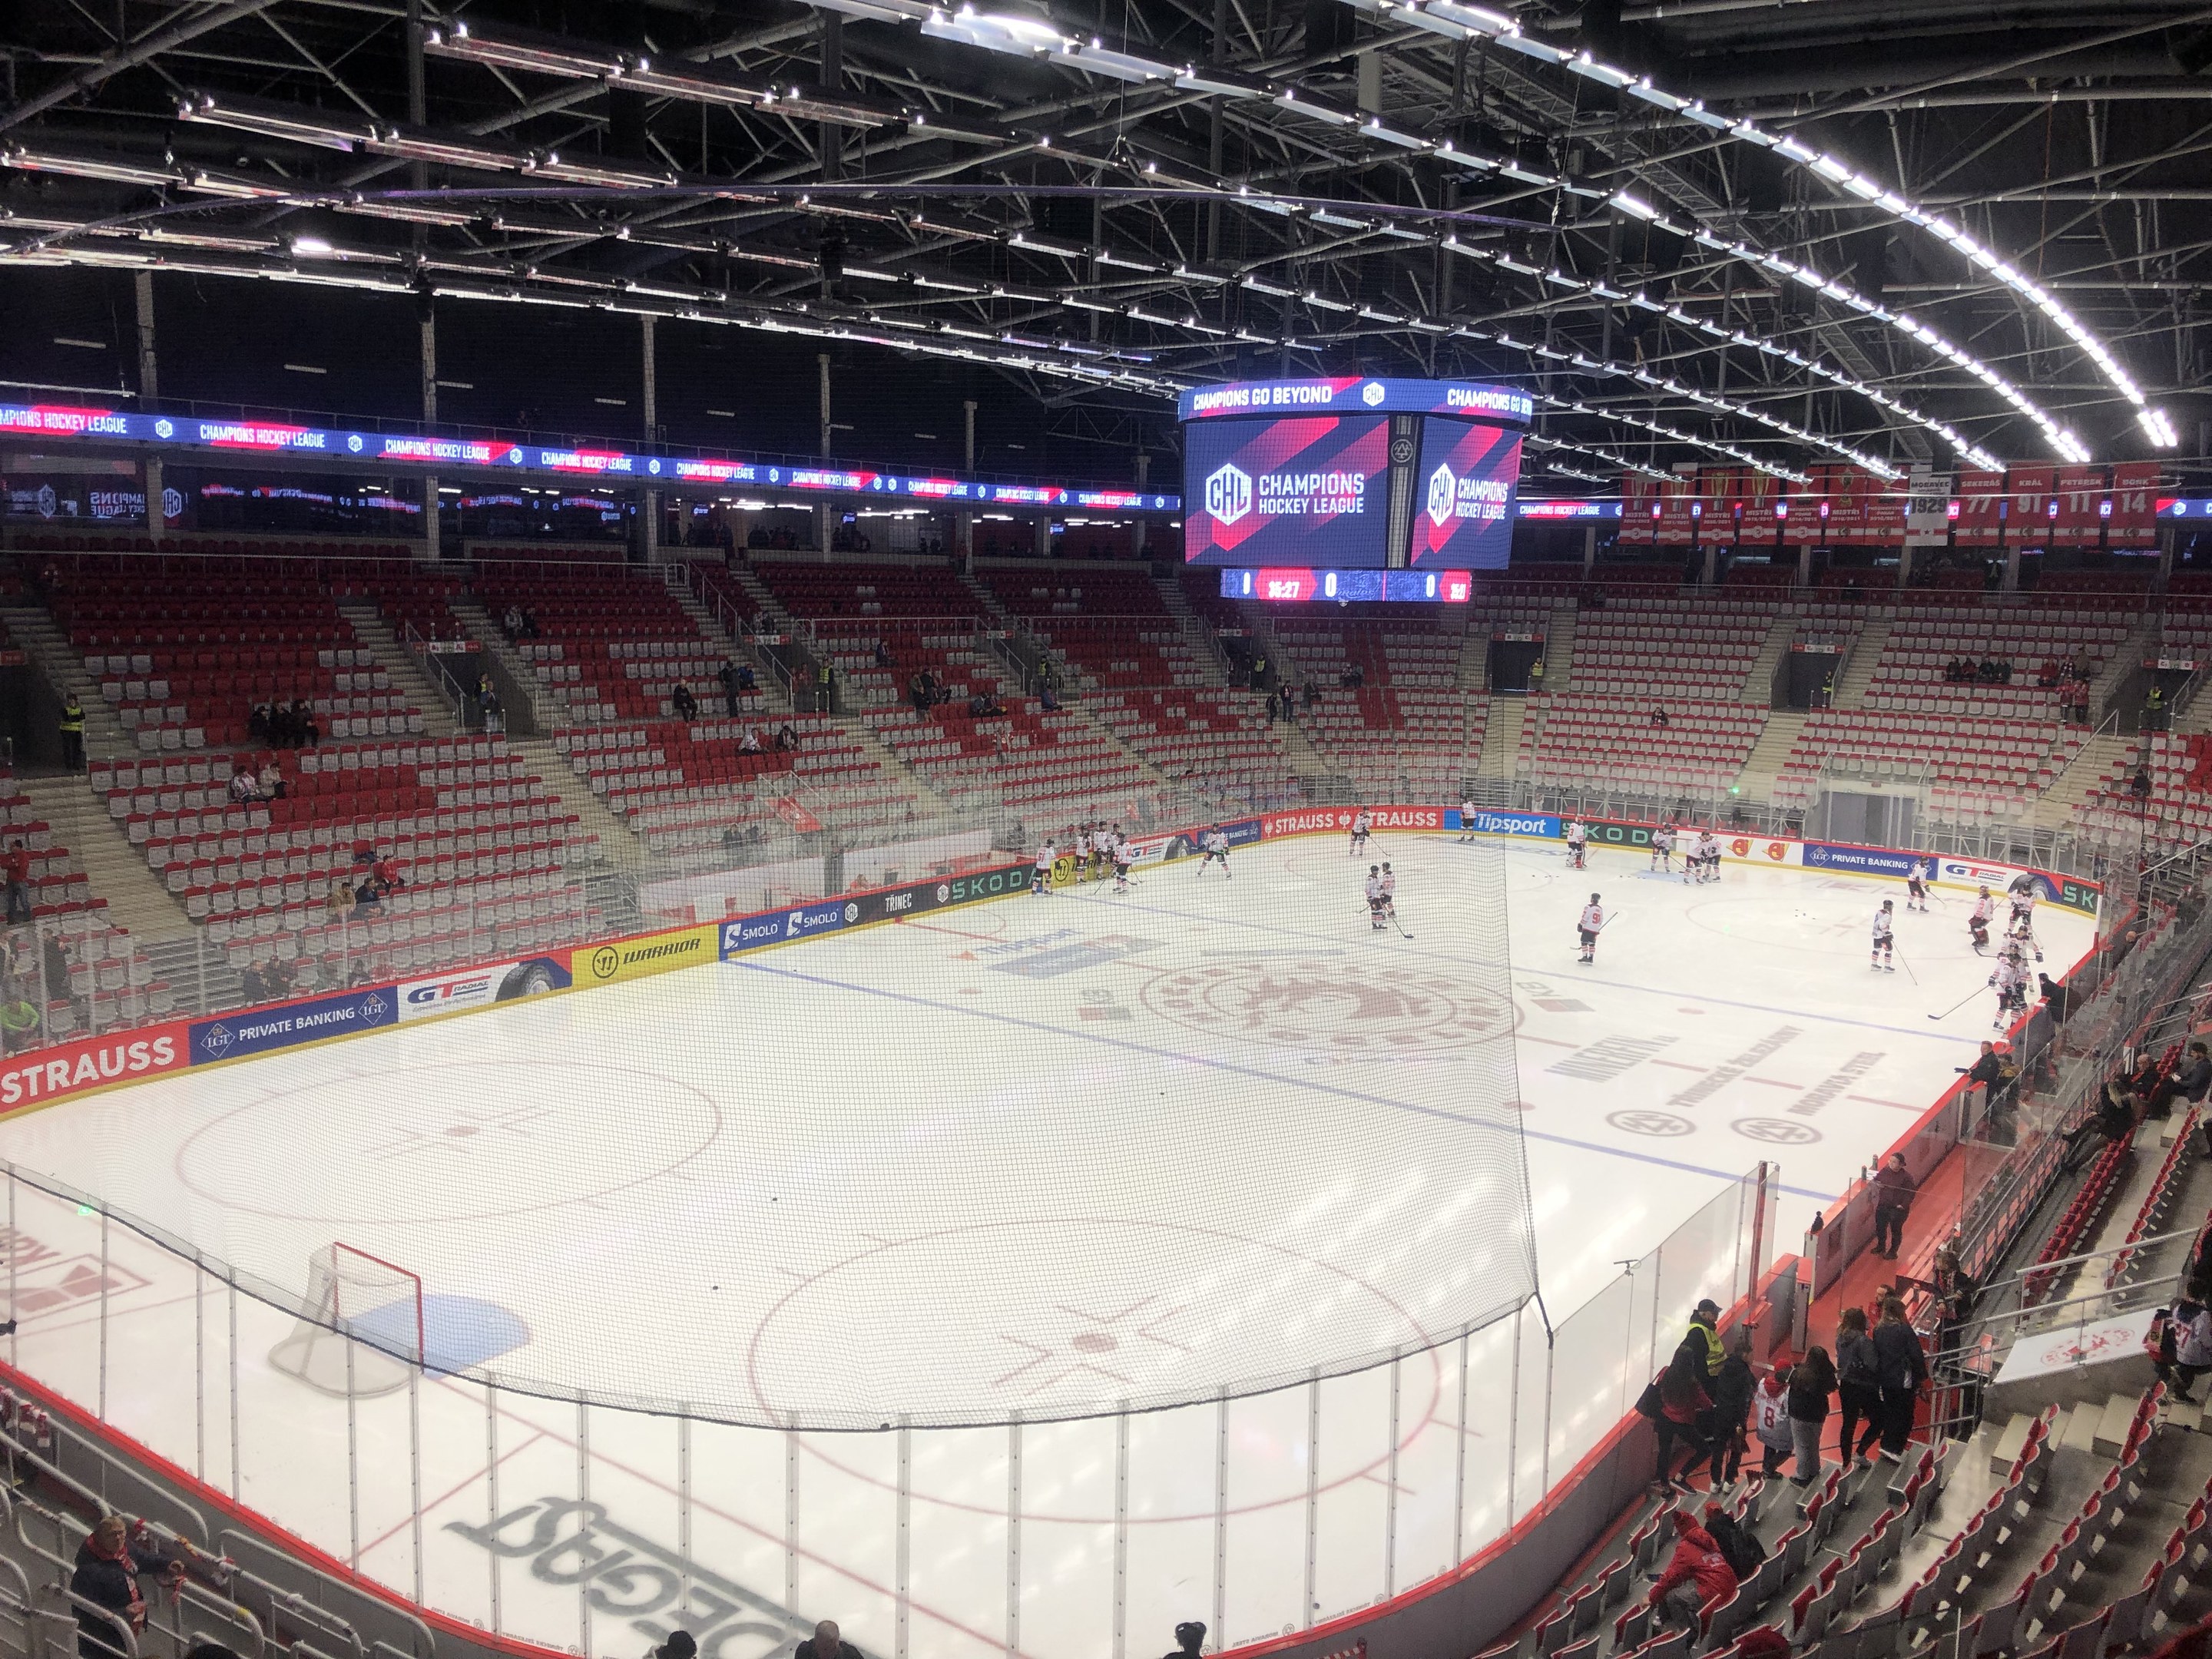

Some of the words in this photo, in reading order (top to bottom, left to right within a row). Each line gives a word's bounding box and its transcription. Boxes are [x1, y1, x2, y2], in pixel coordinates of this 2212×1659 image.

[1194, 389, 1249, 410] CHAMPIONS
[1252, 388, 1270, 406] GO
[1273, 385, 1333, 404] BEYOND
[1447, 389, 1510, 410] CHAMPIONS
[1511, 396, 1521, 412] GO
[45, 412, 84, 431] HOCKEY
[88, 416, 127, 434] LEAGUE
[200, 425, 255, 442] CHAMPIONS
[257, 429, 290, 445] HOCKEY
[293, 432, 325, 448] LEAGUE
[386, 439, 430, 455] CHAMPIONS
[432, 443, 461, 458] HOCKEY
[462, 445, 490, 460] LEAGUE
[541, 452, 581, 467] CHAMPIONS
[581, 455, 607, 469] HOCKEY
[608, 457, 632, 471] LEAGUE
[677, 463, 710, 477] CHAMPIONS
[711, 465, 733, 478] HOCKEY
[733, 467, 754, 480] LEAGUE
[793, 472, 823, 485] CHAMPIONS
[823, 473, 842, 486] HOCKEY
[843, 474, 861, 487] LEAGUE
[1259, 472, 1364, 496] CHAMPIONS
[1457, 478, 1508, 504] CHAMPIONS
[1209, 470, 1251, 521] CHL
[1259, 498, 1309, 514] HOCKEY
[1313, 496, 1364, 514] LEAGUE
[1967, 497, 1992, 513] 77
[2017, 494, 2042, 512] 91
[2069, 494, 2091, 512] 11
[2122, 492, 2146, 513] 14
[1455, 502, 1481, 518] HOCKEY
[1482, 503, 1506, 521] LEAGUE
[1520, 505, 1553, 515] CHAMPIONS
[1555, 506, 1577, 515] HOCKEY
[1578, 505, 1600, 515] LEAGUE
[1911, 497, 1947, 514] 1929
[1325, 573, 1336, 598] 0
[1275, 813, 1333, 835] STRAUSS
[1363, 812, 1437, 826] TRAUSS
[1813, 853, 1828, 861] LGT
[1832, 854, 1866, 866] PRIVATE
[1868, 857, 1909, 869] BANKING
[1945, 865, 1980, 877] GT
[885, 892, 912, 912] TŘINEC
[803, 912, 837, 929] SMOLO
[845, 906, 858, 919] CHL
[742, 925, 778, 941] SMOLO
[623, 938, 700, 965] WARRIOR
[407, 982, 455, 1004] GT
[454, 982, 488, 992] RADIAL
[362, 1002, 384, 1017] LGT
[239, 1020, 292, 1041] PRIVATE
[296, 1007, 355, 1030] BANKING
[207, 1033, 230, 1048] LGT
[1, 1036, 175, 1104] STRAUSS
[1666, 1065, 1746, 1108] TŘINECKÉ
[1786, 1074, 1856, 1116] MORAVIA
[1839, 1051, 1887, 1075] STEEL
[1764, 1406, 1774, 1429] 8
